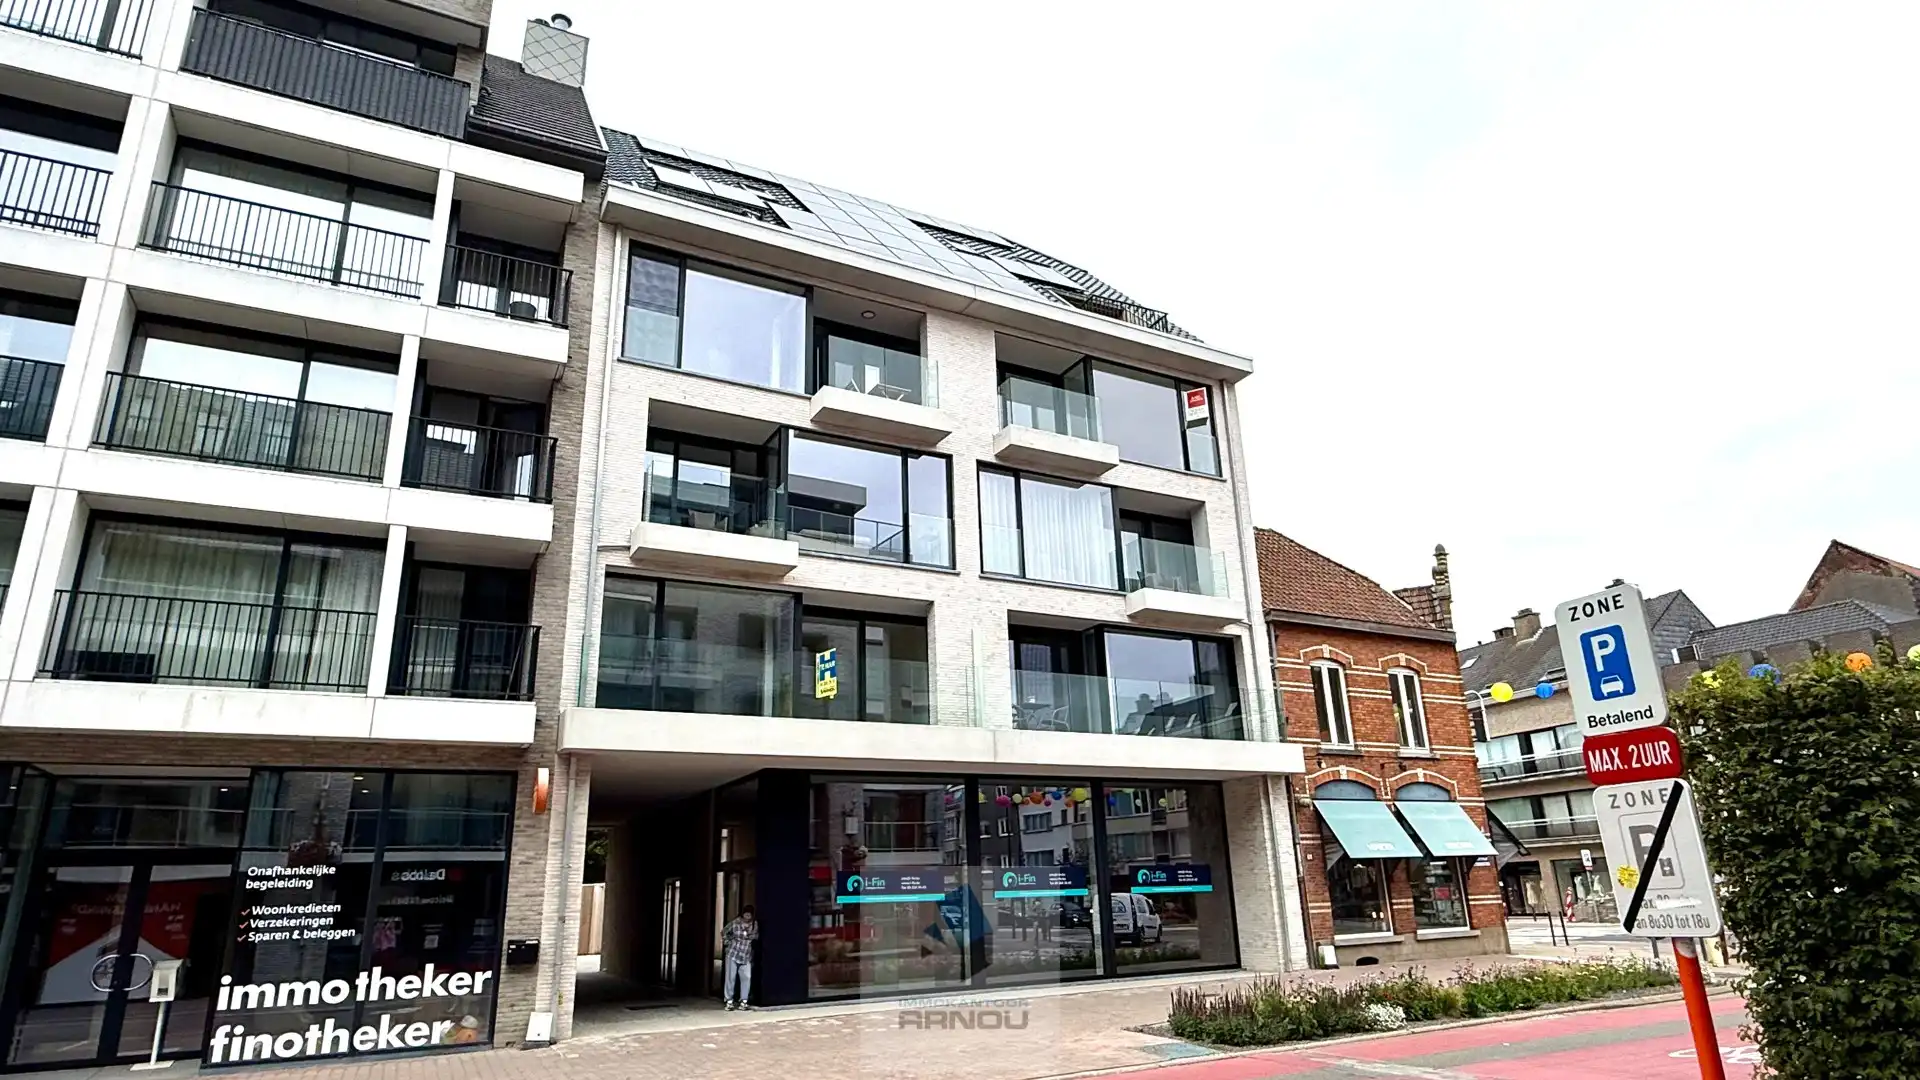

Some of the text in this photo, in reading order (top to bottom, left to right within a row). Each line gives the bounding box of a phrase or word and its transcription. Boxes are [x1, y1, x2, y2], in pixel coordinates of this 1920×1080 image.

[1568, 593, 1624, 622] ZONE
[1590, 633, 1616, 672] P
[1587, 704, 1654, 728] Betalend
[1588, 747, 1628, 773] MAX.
[1608, 787, 1670, 810] ZONE
[247, 864, 336, 878] Onafhankelijke
[245, 877, 314, 891] begeleiding
[252, 903, 341, 915] Woonkredieten
[250, 916, 334, 929] Verzekeringen
[1648, 914, 1674, 929] 8u30
[1675, 914, 1692, 929] tot
[1691, 913, 1710, 929] 18u
[247, 928, 356, 943] Sparen & beleggen
[210, 1013, 455, 1063] finotheker
